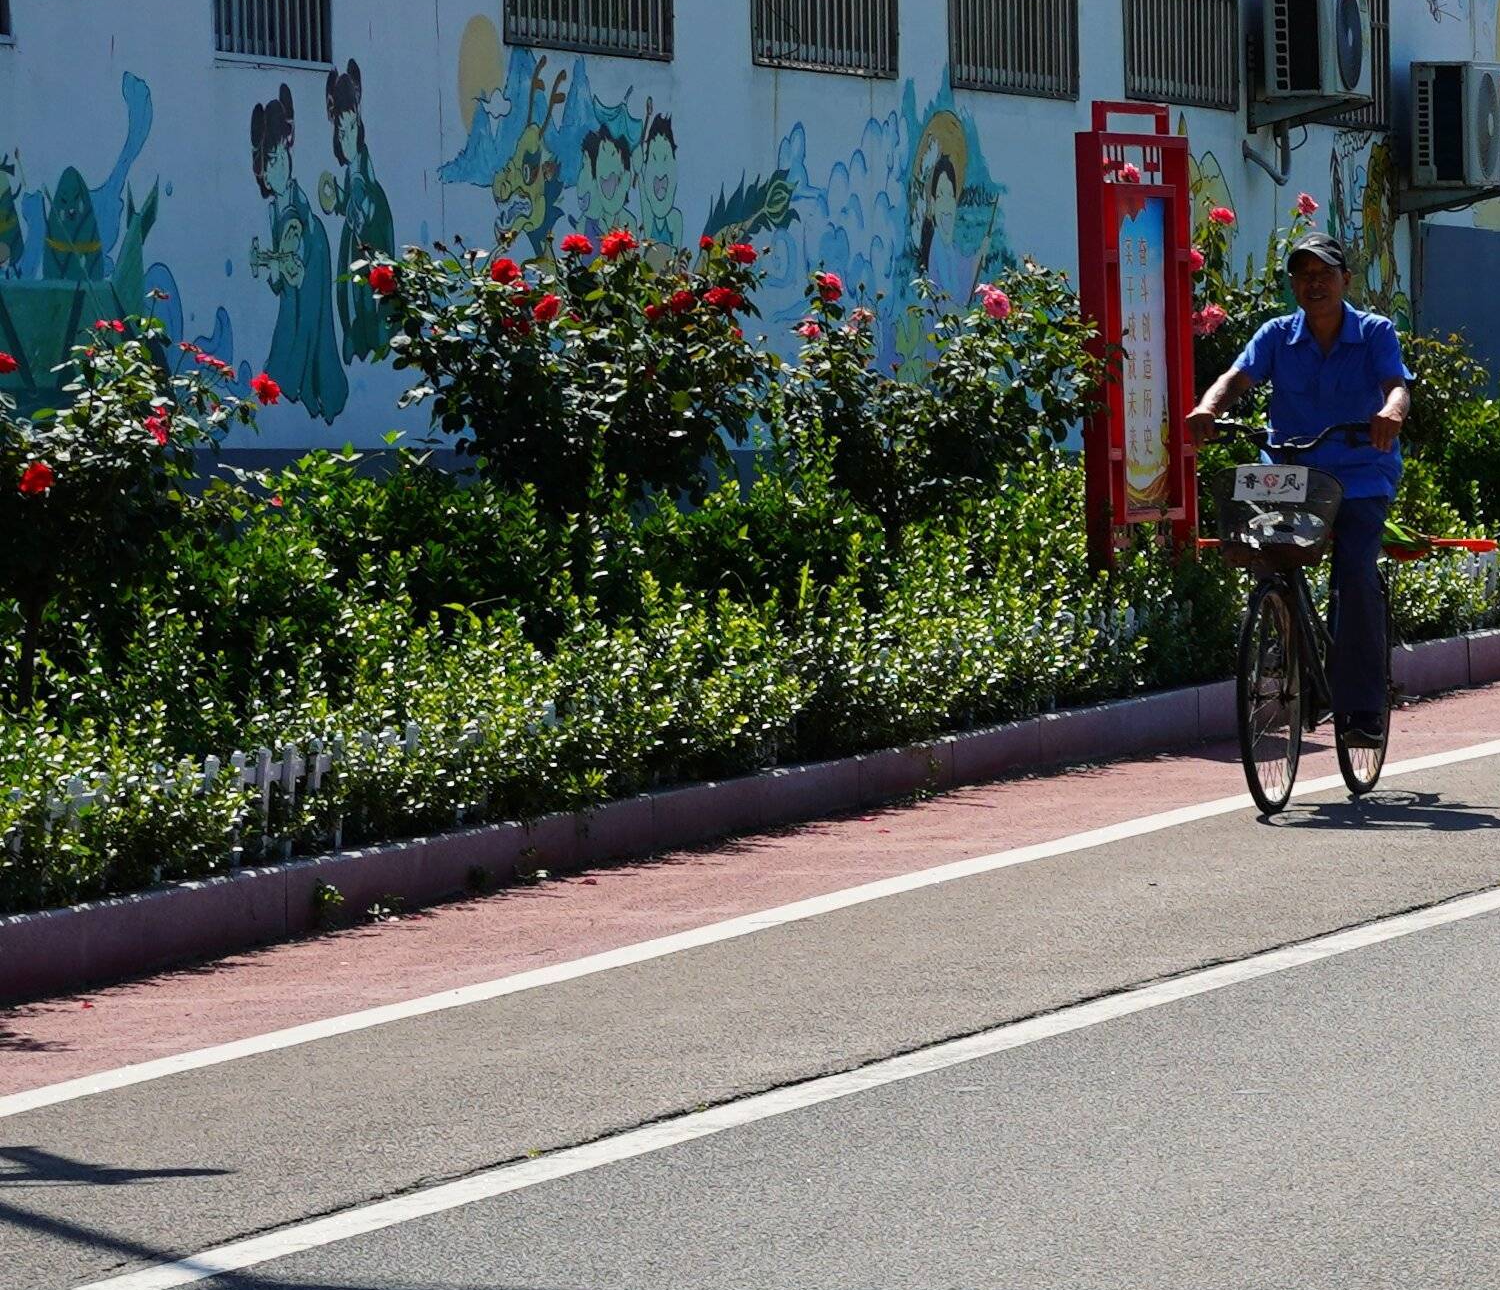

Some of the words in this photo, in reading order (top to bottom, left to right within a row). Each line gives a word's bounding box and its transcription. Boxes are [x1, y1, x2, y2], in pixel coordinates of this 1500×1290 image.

[1124, 237, 1138, 454] 实干成就未来
[1137, 237, 1153, 455] 奋斗创造历史
